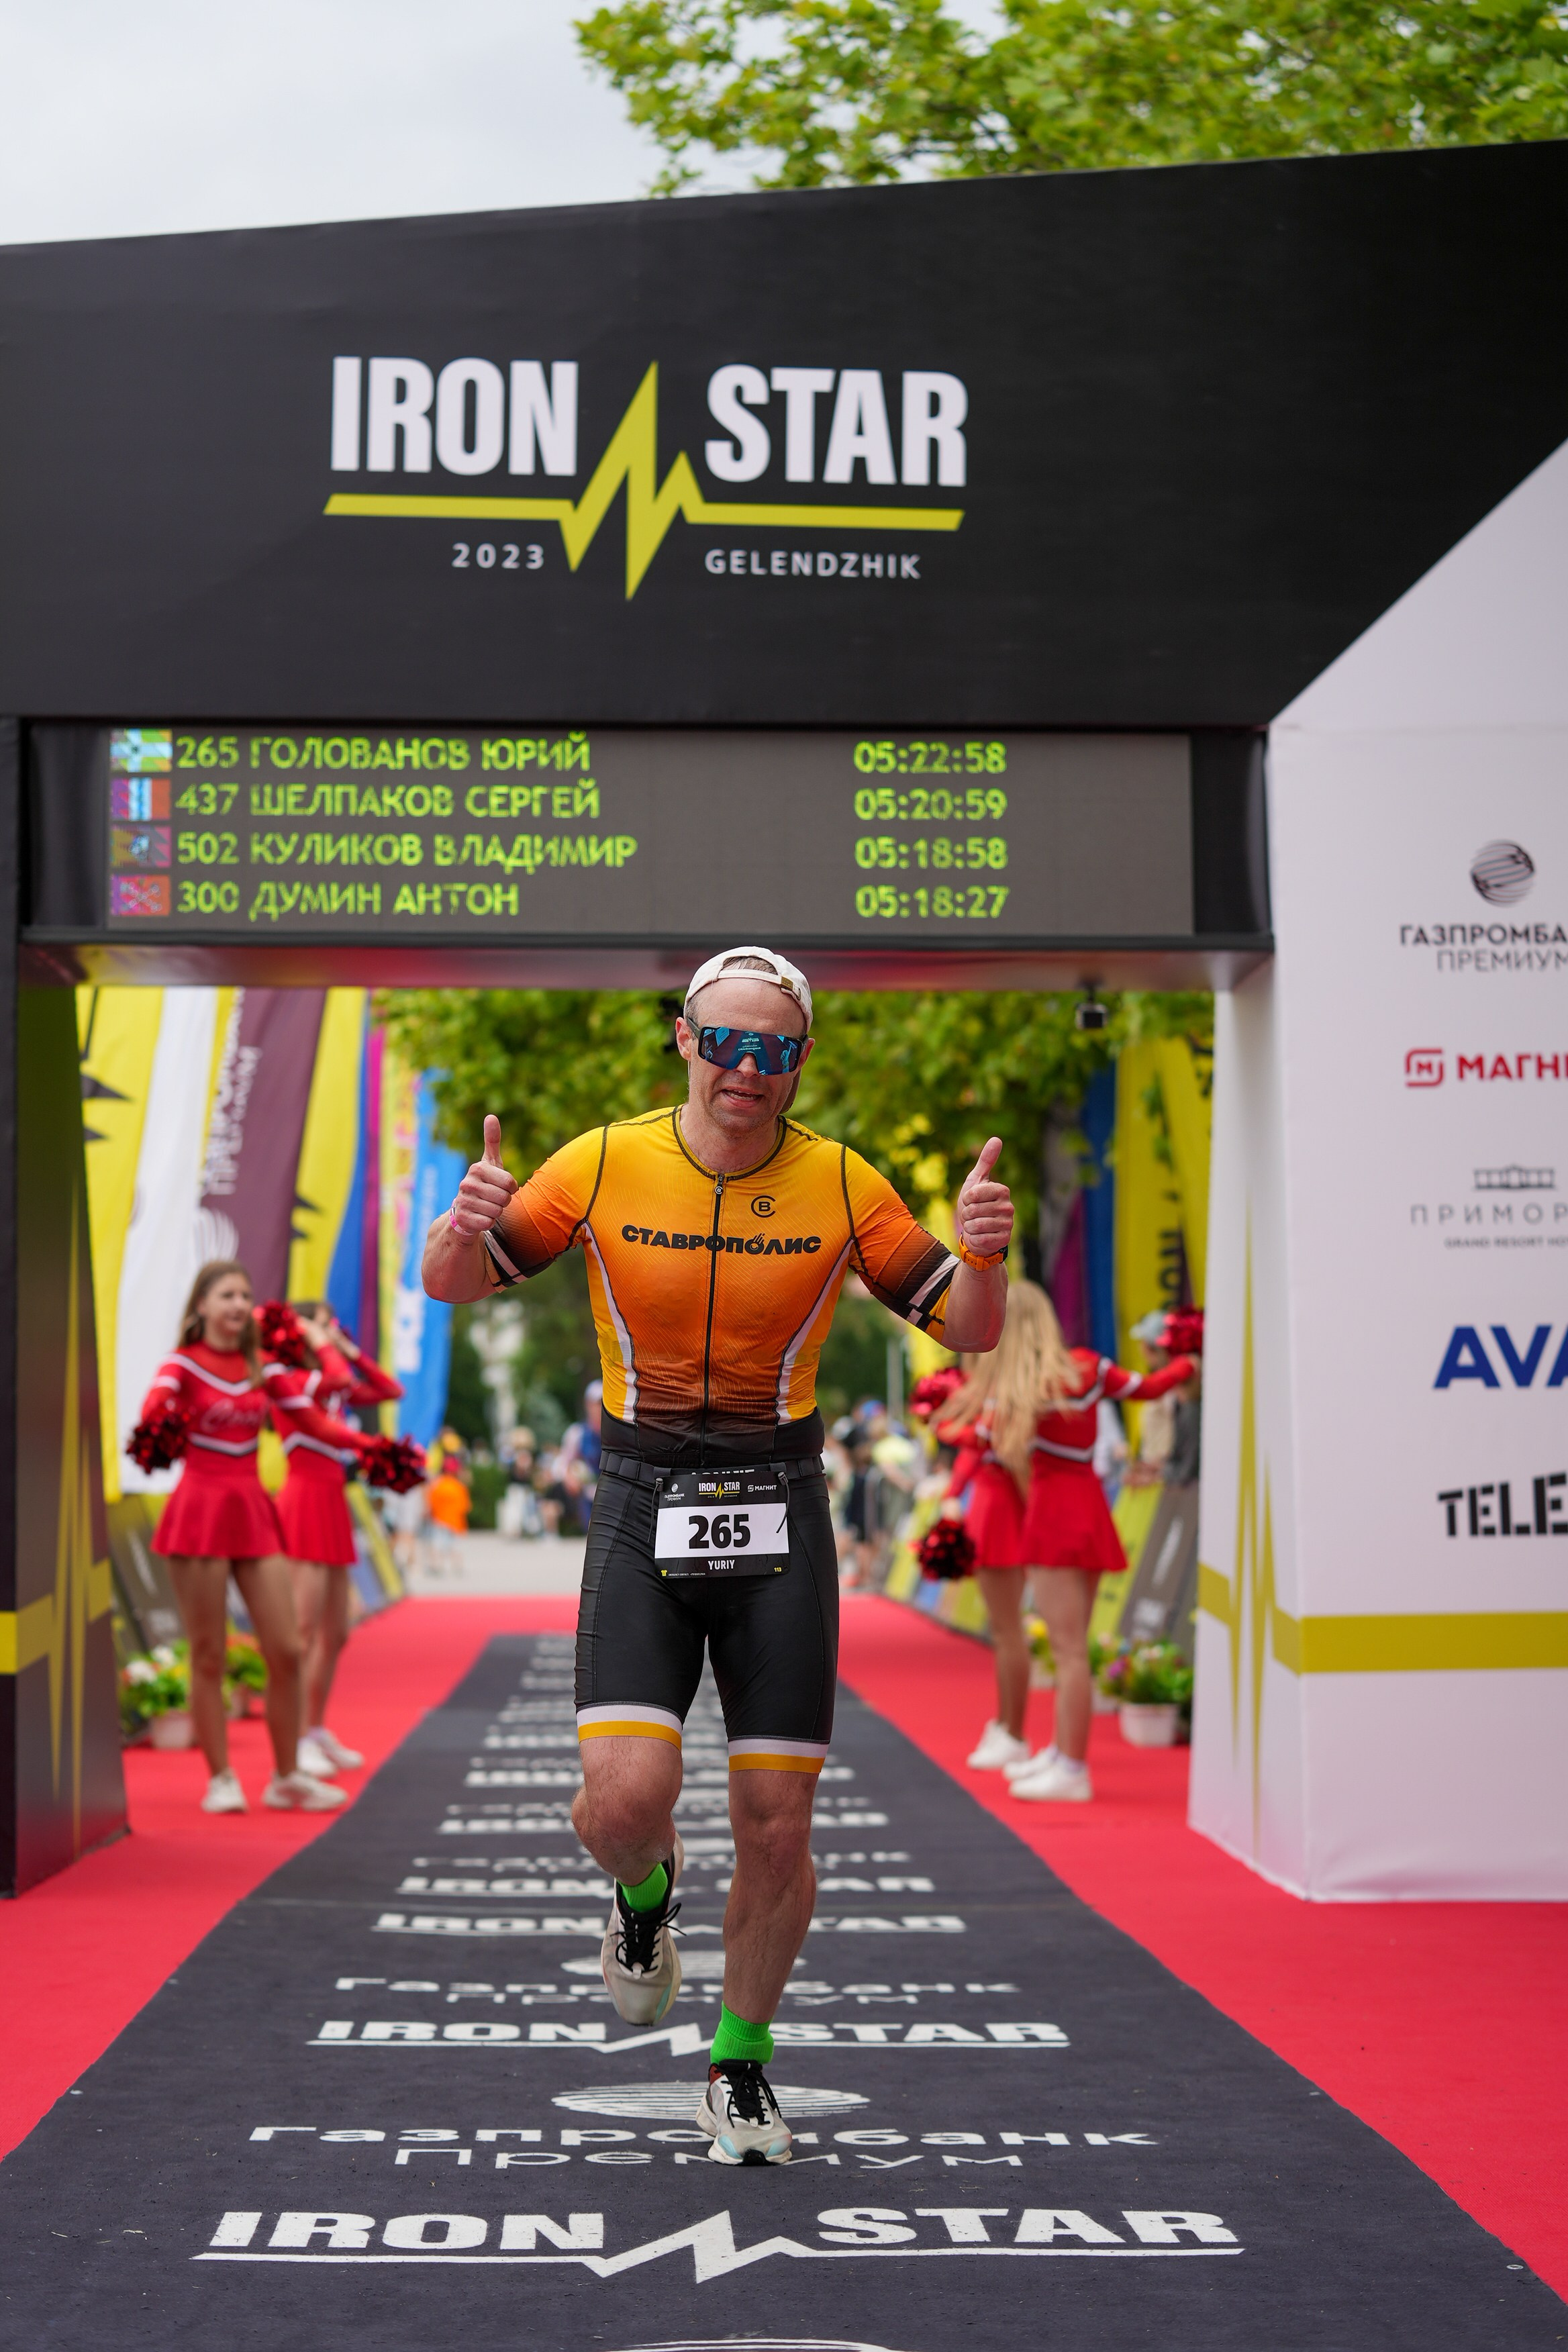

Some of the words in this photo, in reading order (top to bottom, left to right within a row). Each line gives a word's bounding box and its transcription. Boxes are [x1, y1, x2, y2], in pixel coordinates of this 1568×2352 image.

[331, 356, 578, 476] IRON
[705, 363, 968, 487] STAR
[452, 542, 544, 569] 2023
[705, 548, 921, 579] GELENDZHIK
[177, 736, 239, 768] 265
[250, 736, 471, 770] ГОЛОВАНОВ
[481, 731, 591, 771] ЮРИЙ
[853, 740, 1006, 773] 05:22:58
[175, 783, 239, 815] 437
[250, 783, 454, 817] ШЕЛПАКОВ
[464, 778, 600, 818] СЕРГЕЙ
[854, 787, 1007, 820] 05:20:59
[177, 832, 239, 865] 502
[250, 832, 423, 866] КУЛИКОВ
[434, 833, 638, 874] ВЛАДИМИР
[854, 836, 1008, 869] 05:18:58
[177, 881, 240, 914] 300
[248, 881, 382, 921] ДУМИН
[393, 882, 519, 916] АНТОН
[854, 884, 1010, 918] 05:18:27
[1400, 923, 1568, 946] ГАЗПРОМБА
[1457, 1053, 1568, 1081] МАГН
[1410, 1202, 1568, 1226] ПРИМОР
[622, 1224, 822, 1255] СТАВРОПОЛИС
[698, 1482, 716, 1492] IRON
[724, 1481, 740, 1491] STAR
[1437, 1471, 1568, 1538] TELE
[688, 1513, 751, 1549] 265
[707, 1559, 735, 1570] YURIY
[317, 2020, 606, 2041] IRON
[768, 2022, 1069, 2042] STAR
[209, 2211, 603, 2249] IRON
[817, 2206, 1240, 2244] STAR
